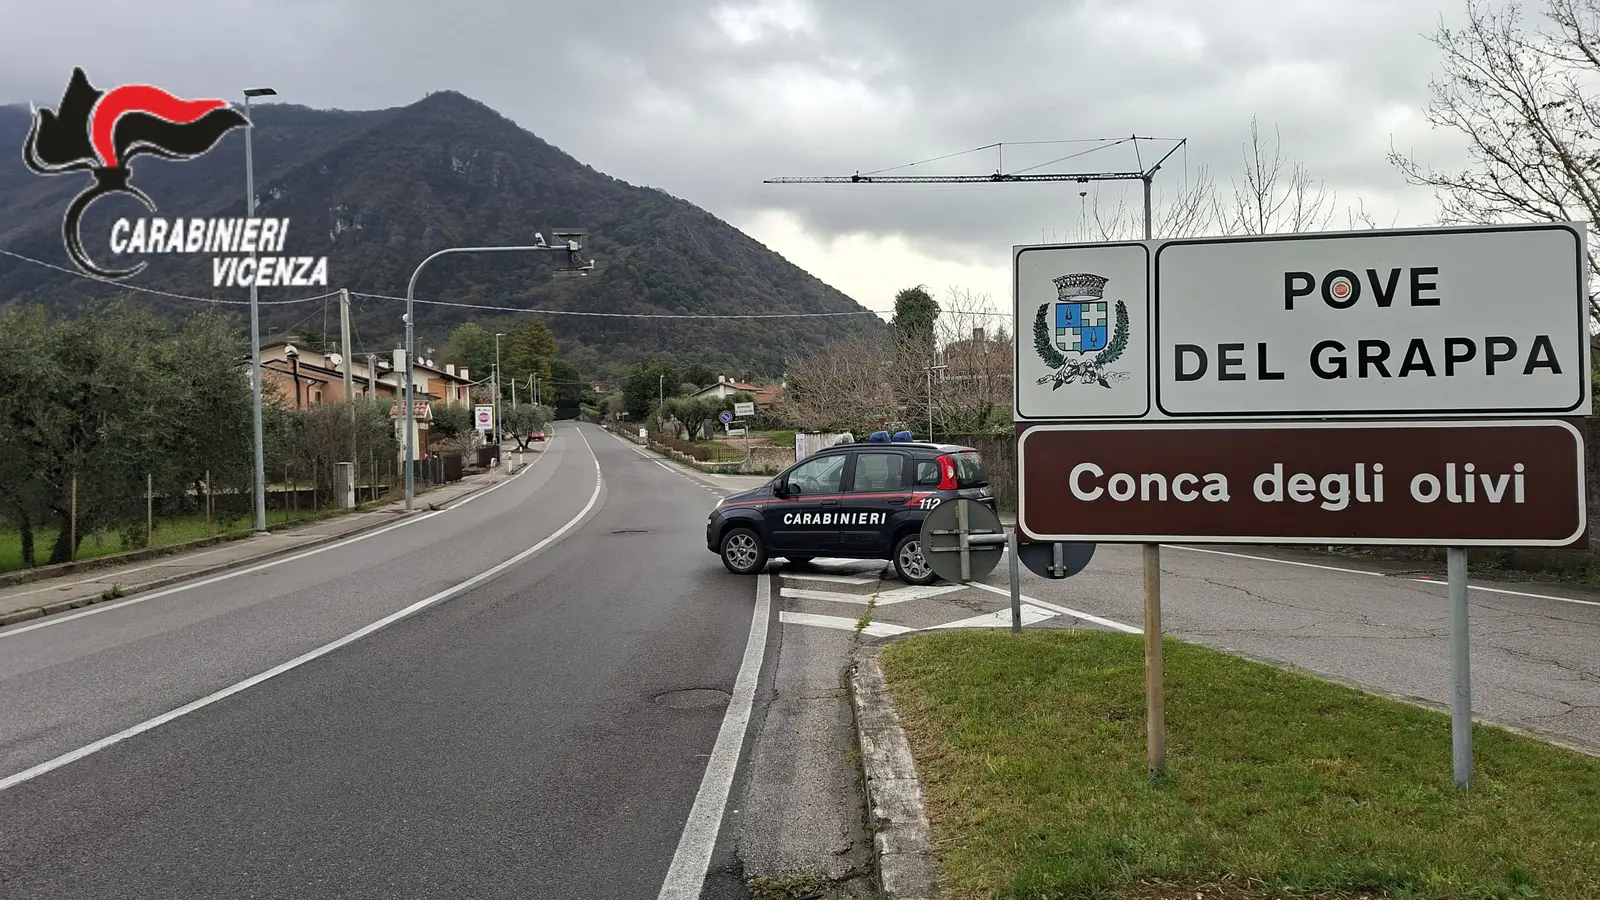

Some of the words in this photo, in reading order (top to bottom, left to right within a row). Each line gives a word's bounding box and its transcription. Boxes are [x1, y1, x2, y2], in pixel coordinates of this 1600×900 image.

[1285, 267, 1440, 310] POVE
[1175, 343, 1284, 381] DEL
[1310, 335, 1562, 379] GRAPPA
[919, 498, 941, 510] 112
[1069, 462, 1230, 502] Conca
[1253, 462, 1384, 511] degli
[1410, 462, 1525, 503] olivi
[783, 512, 887, 525] CARABINIERI
